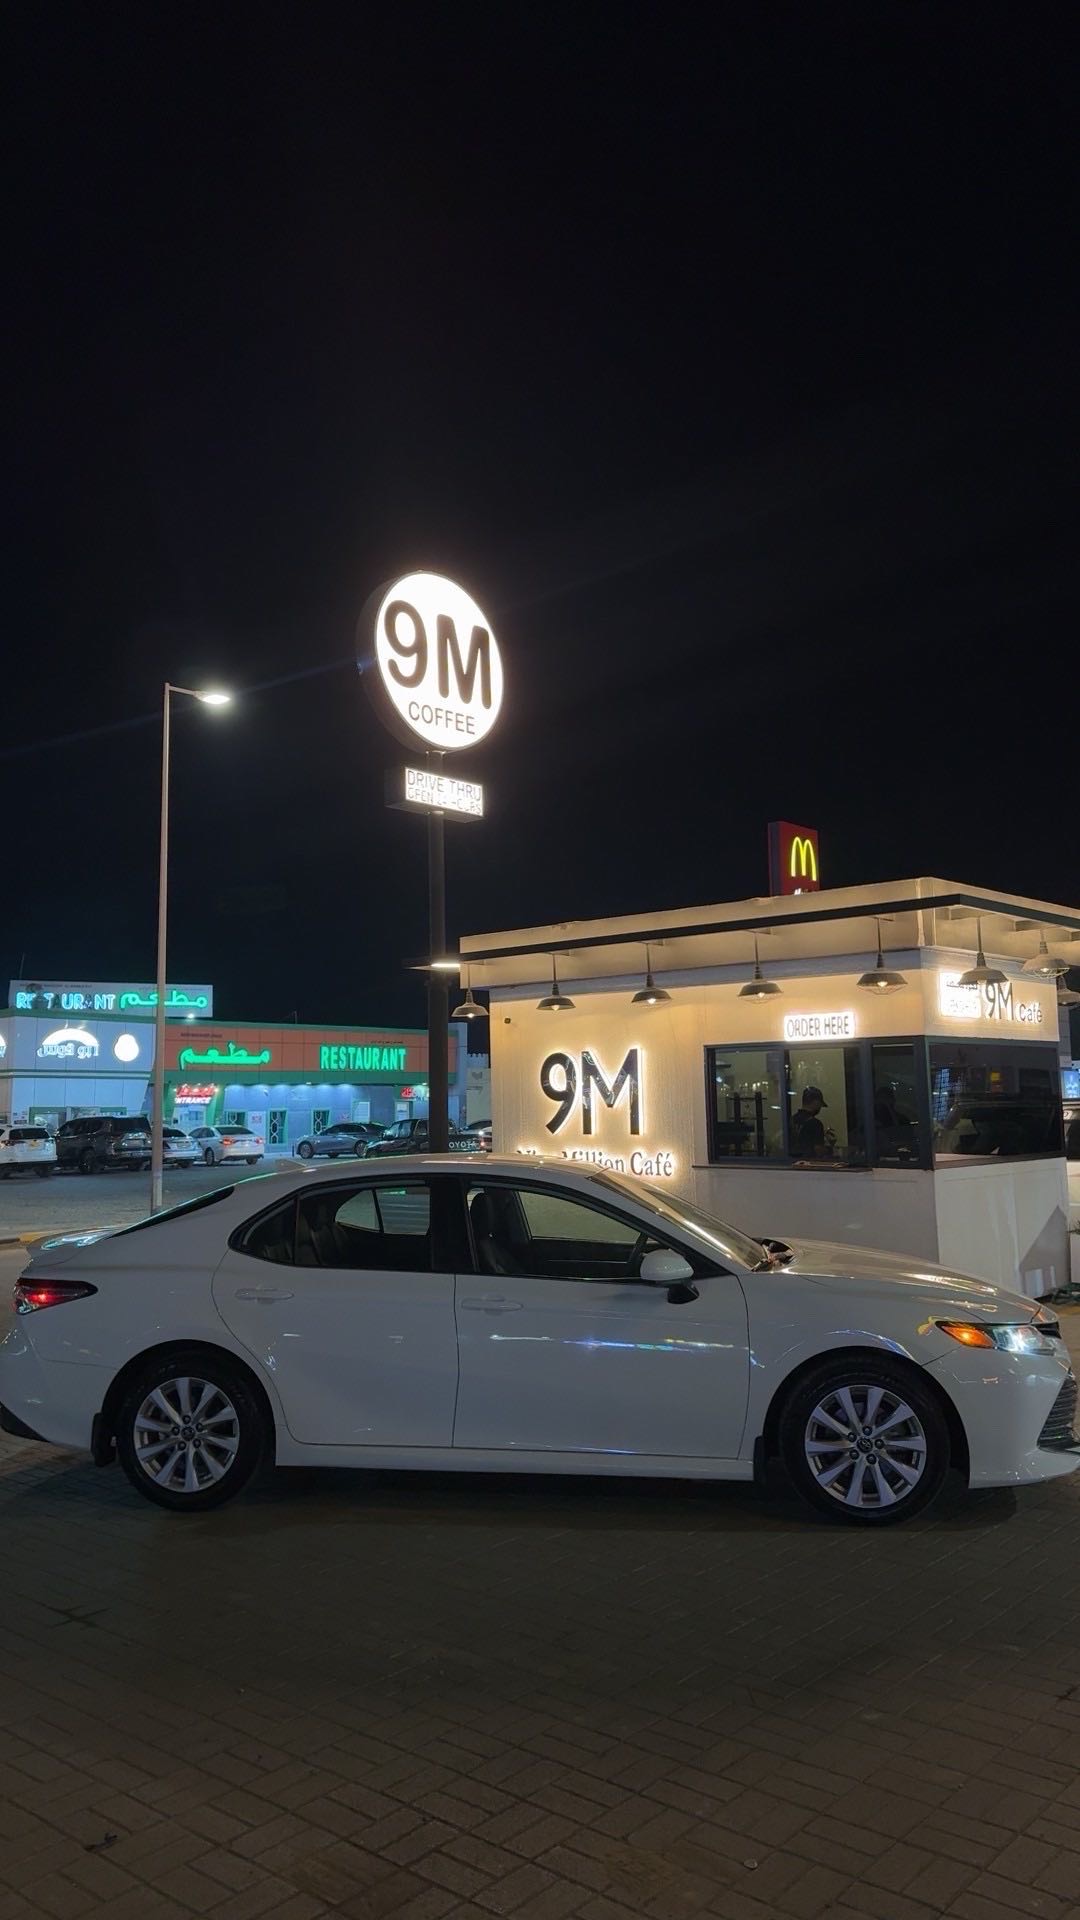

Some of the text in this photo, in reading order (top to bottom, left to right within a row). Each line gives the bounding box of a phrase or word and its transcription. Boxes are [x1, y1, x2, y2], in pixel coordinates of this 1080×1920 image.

[384, 600, 491, 710] 9M
[408, 701, 475, 735] COFFEE
[407, 769, 444, 793] DRIVE
[449, 779, 481, 802] THRU
[985, 981, 1014, 1020] 9M
[786, 1015, 849, 1038] ORDER HERE
[320, 1045, 406, 1071] RESTAURANT
[540, 1048, 641, 1136] 9M
[448, 1141, 477, 1149] OYOTA
[630, 1151, 673, 1177] Café
